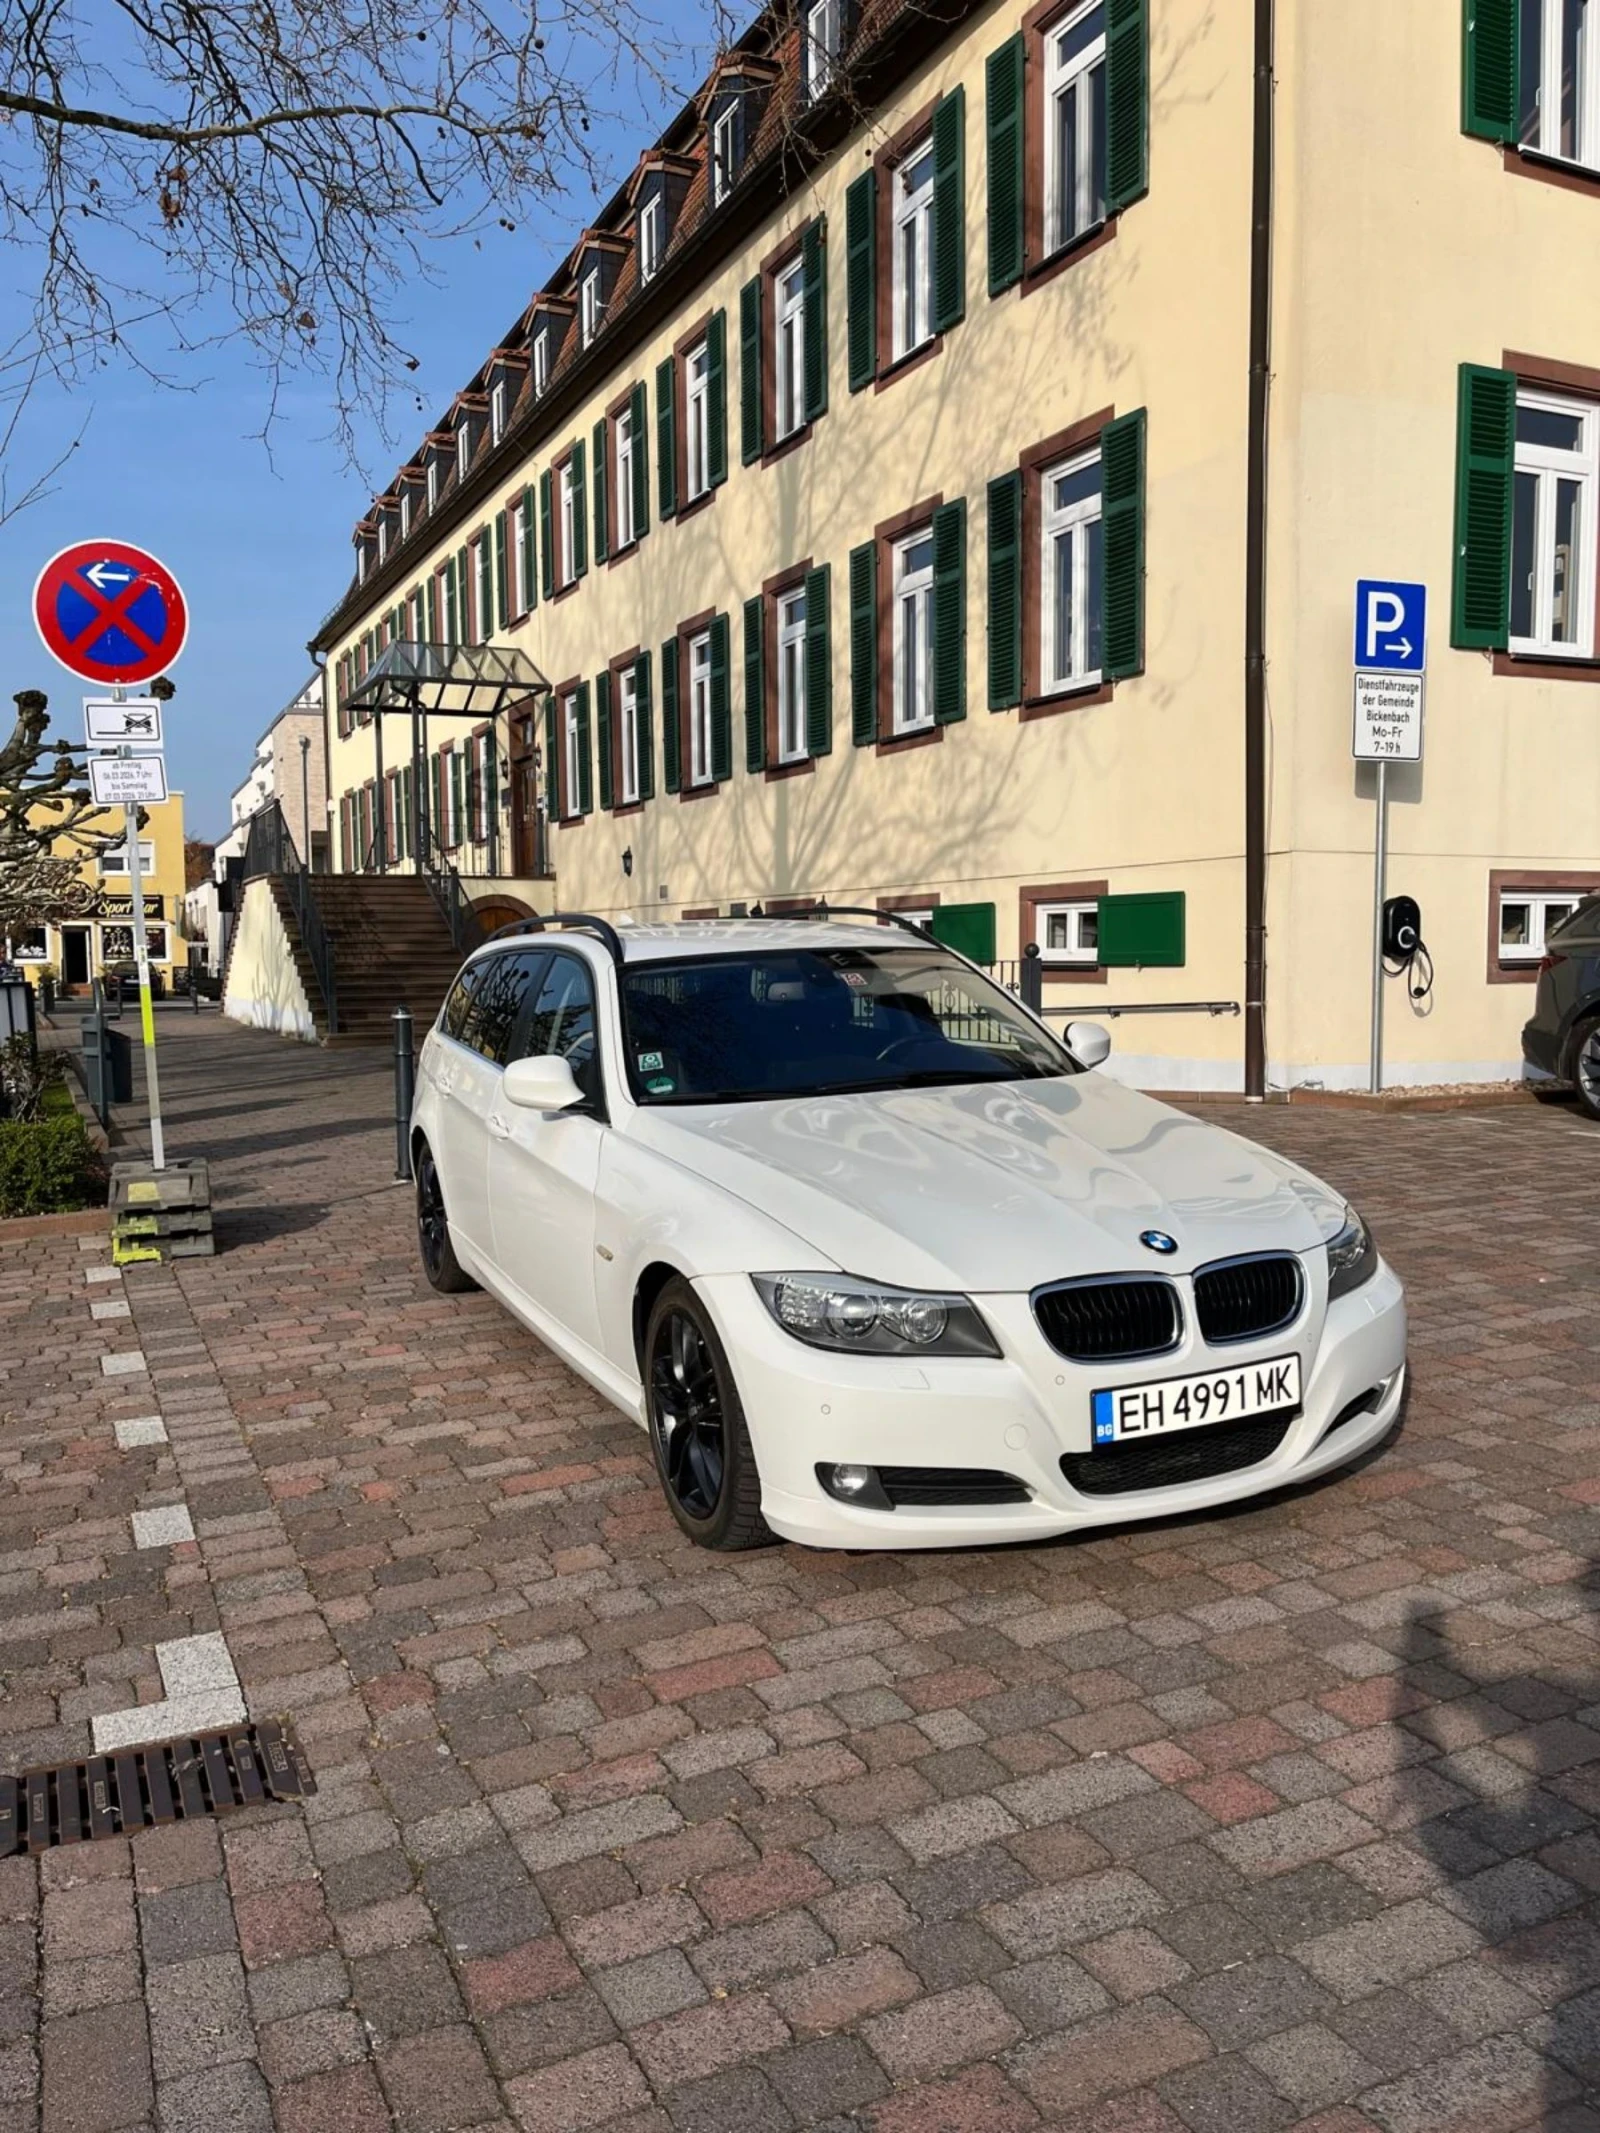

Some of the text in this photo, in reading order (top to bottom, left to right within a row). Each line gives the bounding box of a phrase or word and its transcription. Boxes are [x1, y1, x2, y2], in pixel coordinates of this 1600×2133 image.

[1366, 591, 1405, 657] P
[1358, 677, 1419, 695] Dienstfahrzeuge
[1362, 694, 1415, 708] der Gemeinde
[1366, 709, 1410, 723] Bickenbach
[1372, 725, 1403, 738] Mo-Fr
[1374, 740, 1401, 754] 7-19 h
[120, 761, 142, 770] Freitag
[141, 770, 152, 779] Uhr
[111, 782, 148, 791] bis Samstag
[145, 791, 156, 799] Uhr
[97, 900, 132, 918] Sport
[1119, 1363, 1293, 1434] EH 4991 MK
[1096, 1424, 1113, 1437] BG
